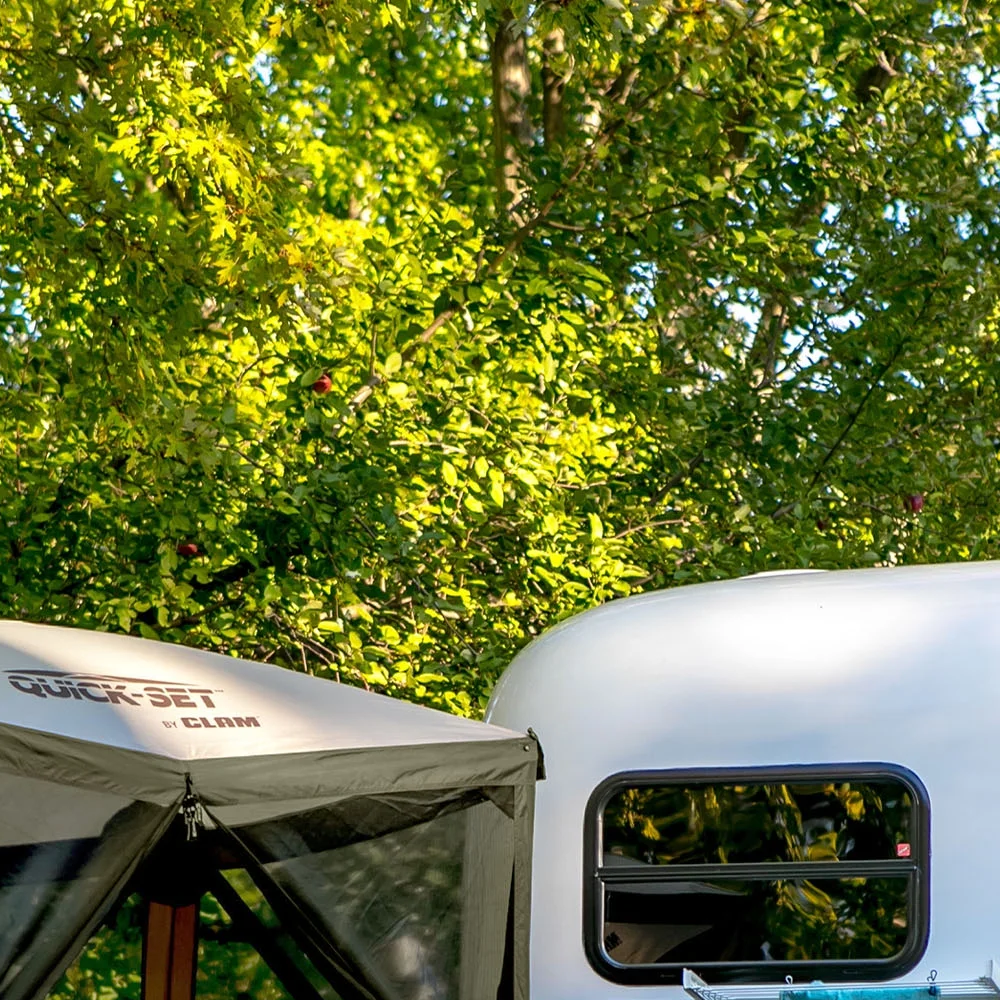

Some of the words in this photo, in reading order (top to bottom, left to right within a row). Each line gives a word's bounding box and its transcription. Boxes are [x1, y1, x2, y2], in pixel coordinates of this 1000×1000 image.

[7, 675, 217, 708] QUICK-SET
[162, 720, 178, 728] BY
[180, 716, 261, 728] CLAM
